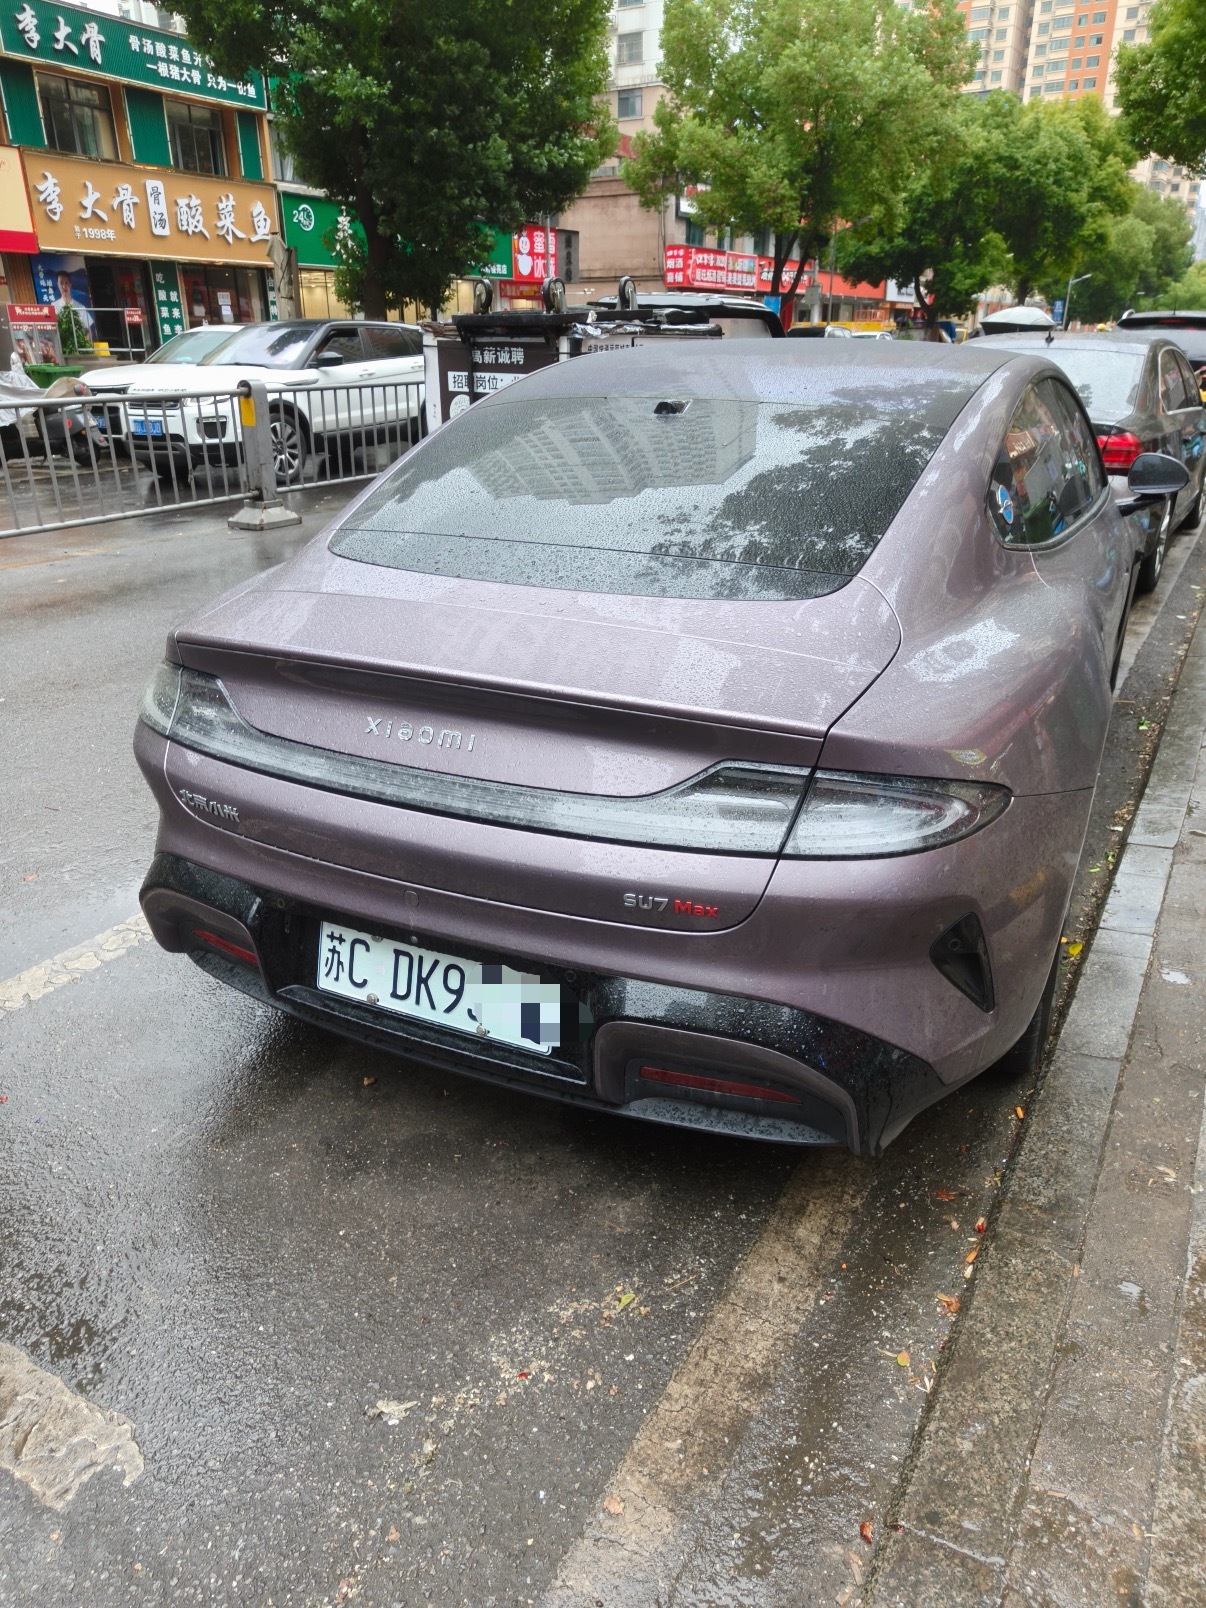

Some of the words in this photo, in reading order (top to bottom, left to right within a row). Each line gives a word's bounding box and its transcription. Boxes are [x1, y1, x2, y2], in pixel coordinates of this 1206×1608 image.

[15, 4, 105, 65] 李大骨
[35, 171, 140, 229] 李大骨
[150, 186, 167, 230] 骨汤
[175, 193, 271, 244] 酸菜鱼
[83, 227, 117, 241] 1998年
[155, 272, 172, 335] 吃酸菜鱼
[179, 789, 241, 823] 北京小米
[623, 893, 668, 912] SU7
[673, 899, 719, 918] Max
[324, 931, 371, 990] 苏C
